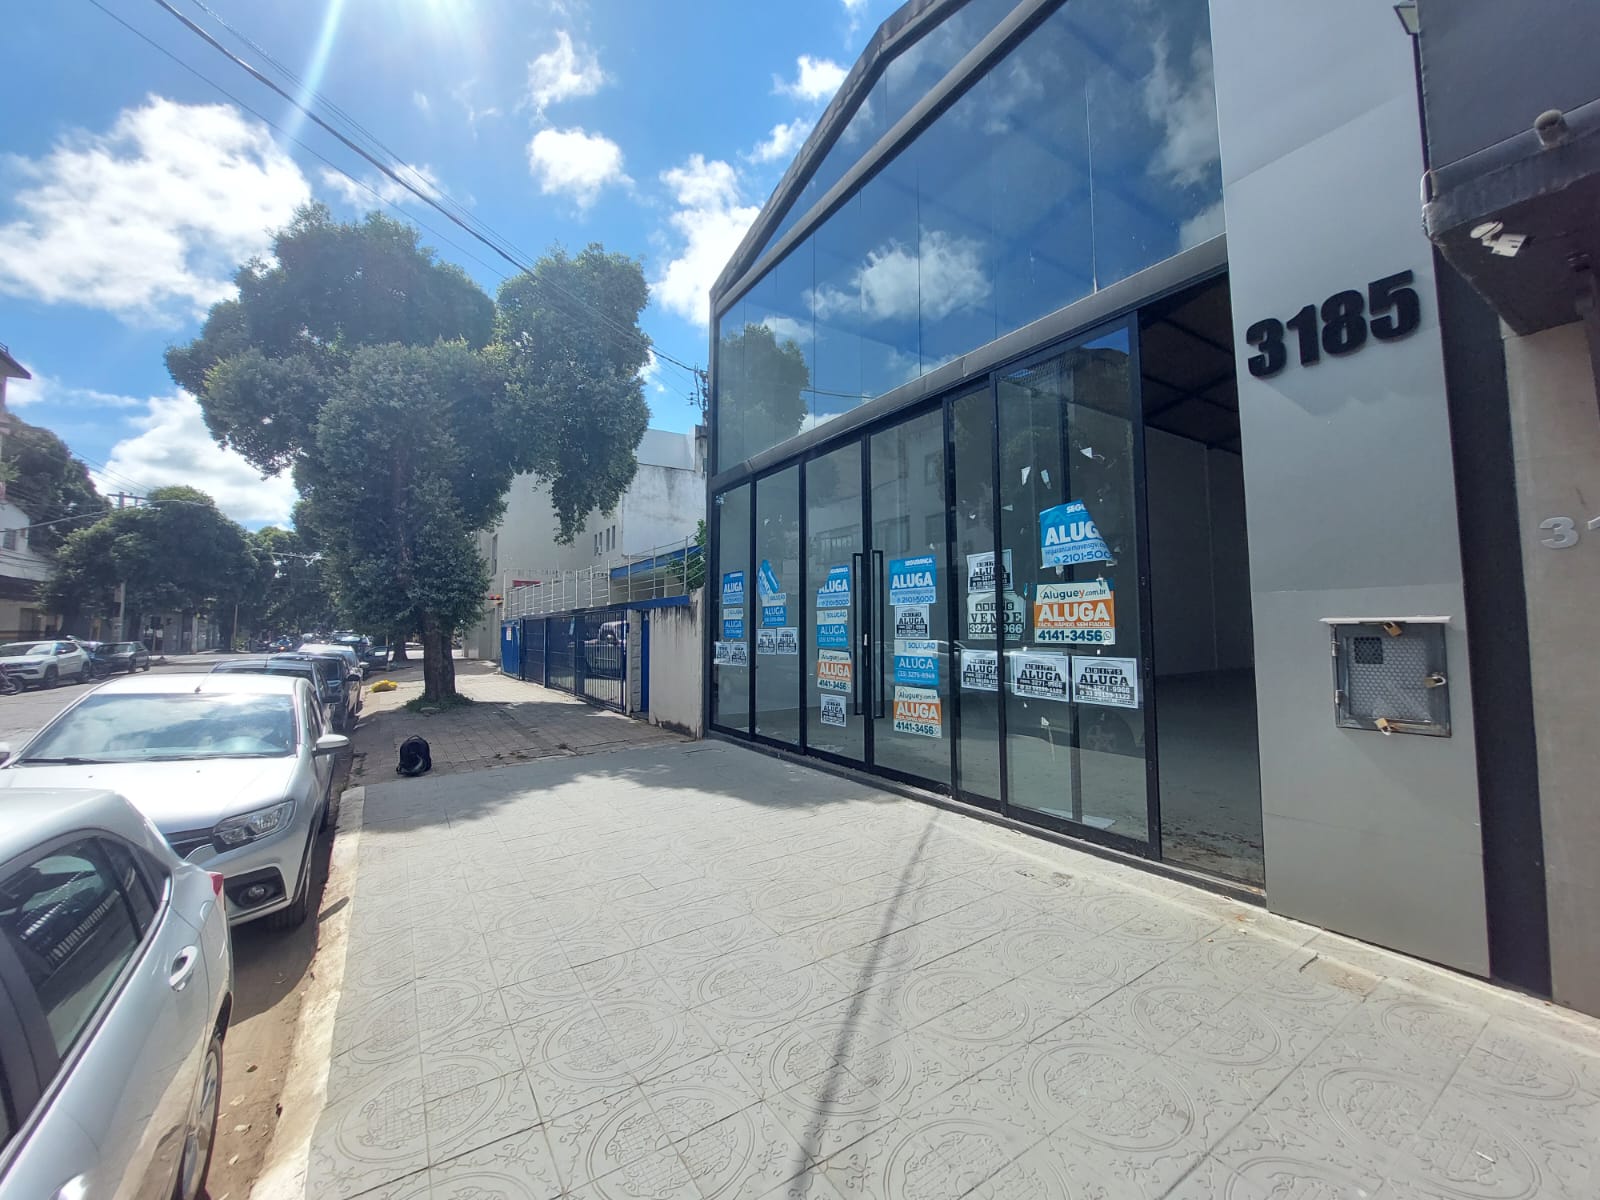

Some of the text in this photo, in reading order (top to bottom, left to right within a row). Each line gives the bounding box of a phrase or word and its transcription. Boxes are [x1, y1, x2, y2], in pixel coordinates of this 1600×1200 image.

[1246, 269, 1421, 377] 3185
[891, 571, 933, 589] ALUGA
[723, 582, 743, 593] ALUGA
[765, 607, 784, 615] ALUGA
[976, 602, 1014, 611] ABIS
[1039, 602, 1110, 622] ALUGA
[725, 620, 742, 628] ALUGA
[899, 617, 925, 625] ALUGA
[821, 625, 845, 634] ALUGA
[1038, 629, 1103, 641] 4141-3456
[899, 657, 934, 669] ALUGA
[820, 662, 850, 677] ALUGA
[1020, 670, 1062, 681] ALUGA
[1080, 674, 1129, 686] ALUGA
[896, 702, 939, 719] ALUGA
[896, 721, 934, 735] 4141-3456
